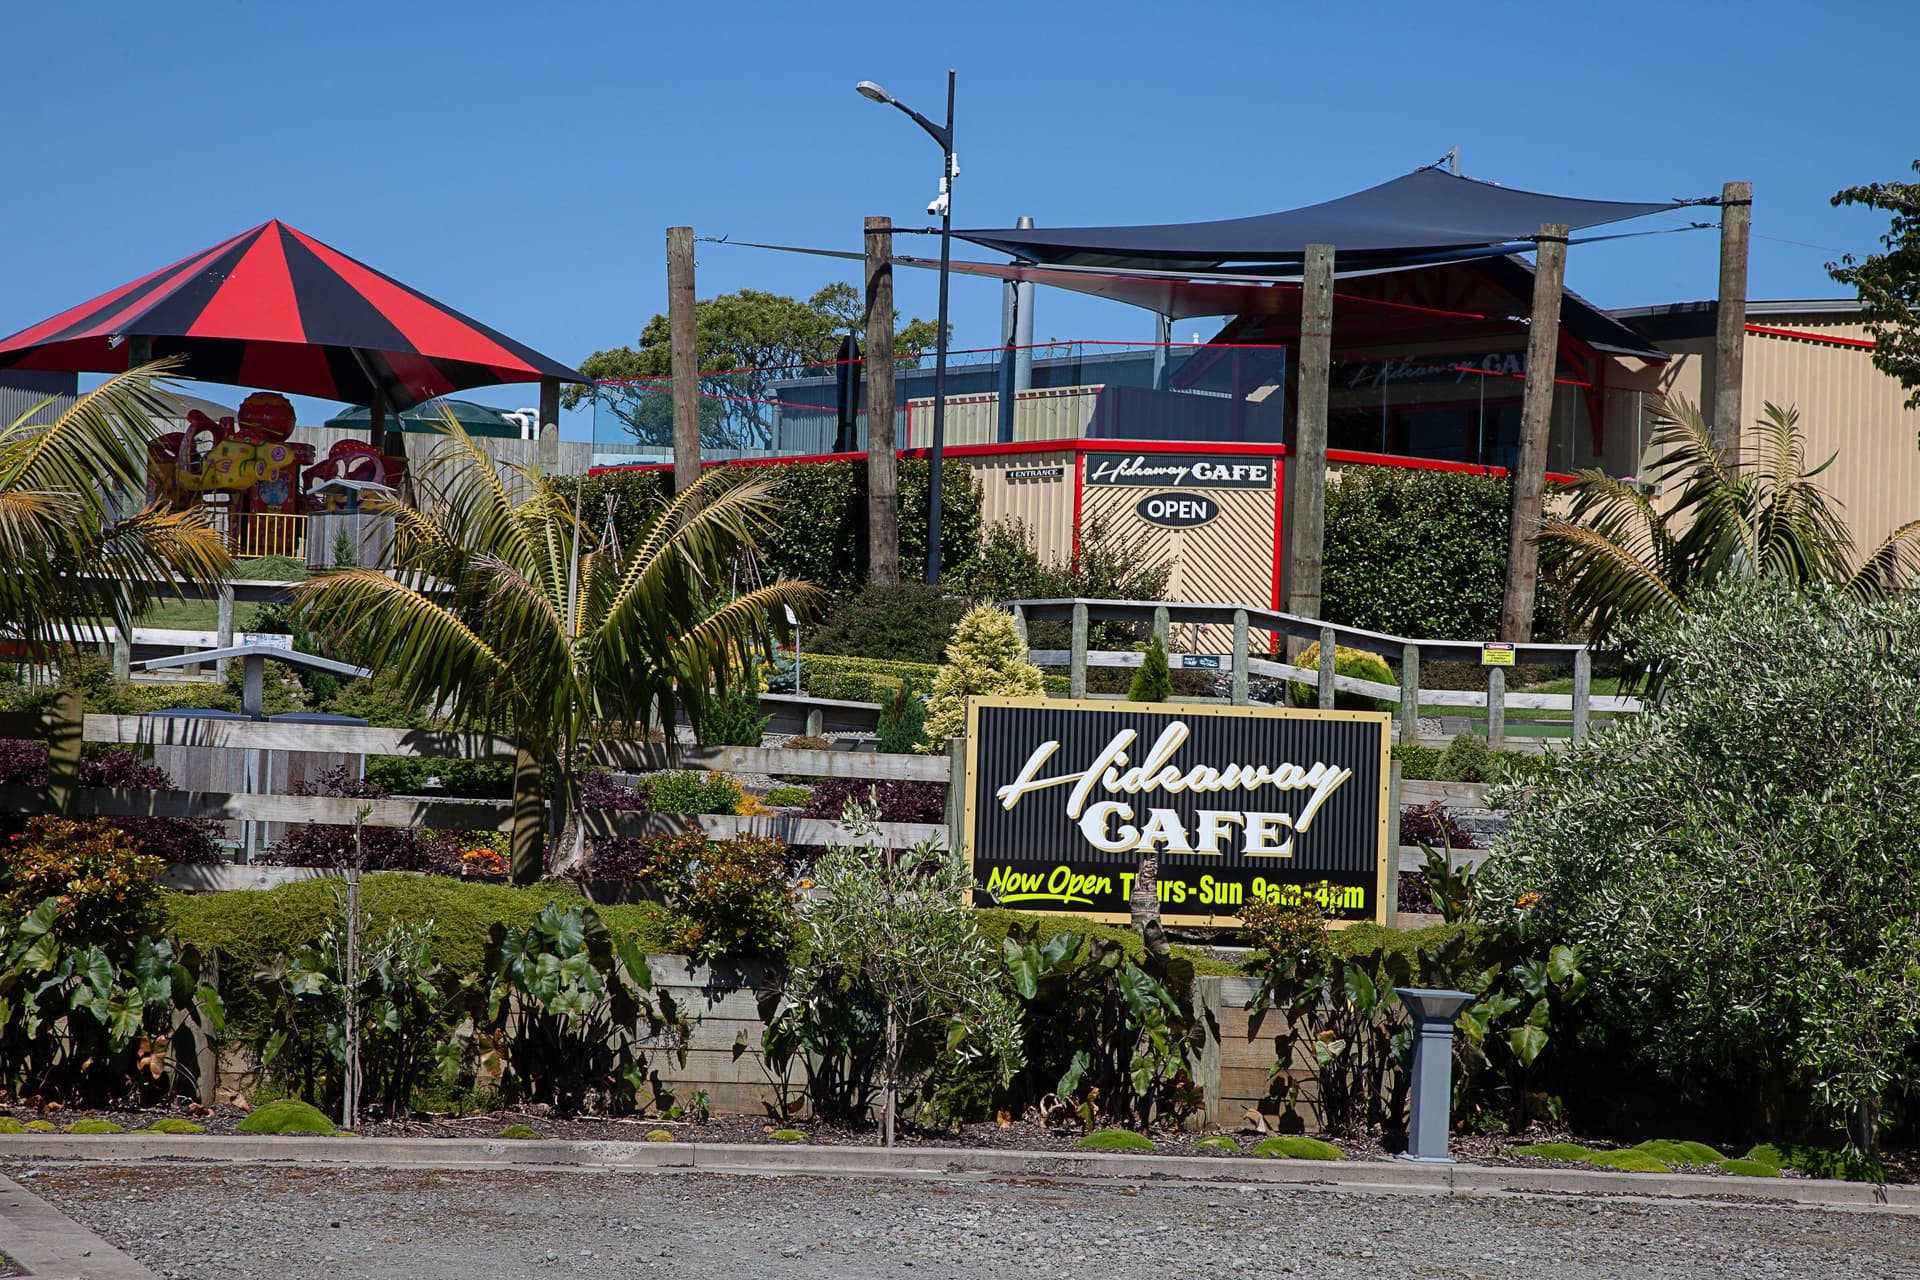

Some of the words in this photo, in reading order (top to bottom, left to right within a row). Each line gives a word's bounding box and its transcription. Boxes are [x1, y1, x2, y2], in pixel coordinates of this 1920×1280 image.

[1482, 353, 1528, 374] CA
[1015, 469, 1058, 478] ENTRANCE
[1091, 456, 1190, 486] Hideaway
[1191, 462, 1268, 481] CAFE
[1147, 500, 1208, 519] OPEN
[996, 720, 1353, 833] Hideaway
[1077, 800, 1294, 857] CAFE
[987, 865, 1045, 894] Now
[1047, 865, 1113, 904] Open
[1119, 872, 1243, 905] Trs-Sun
